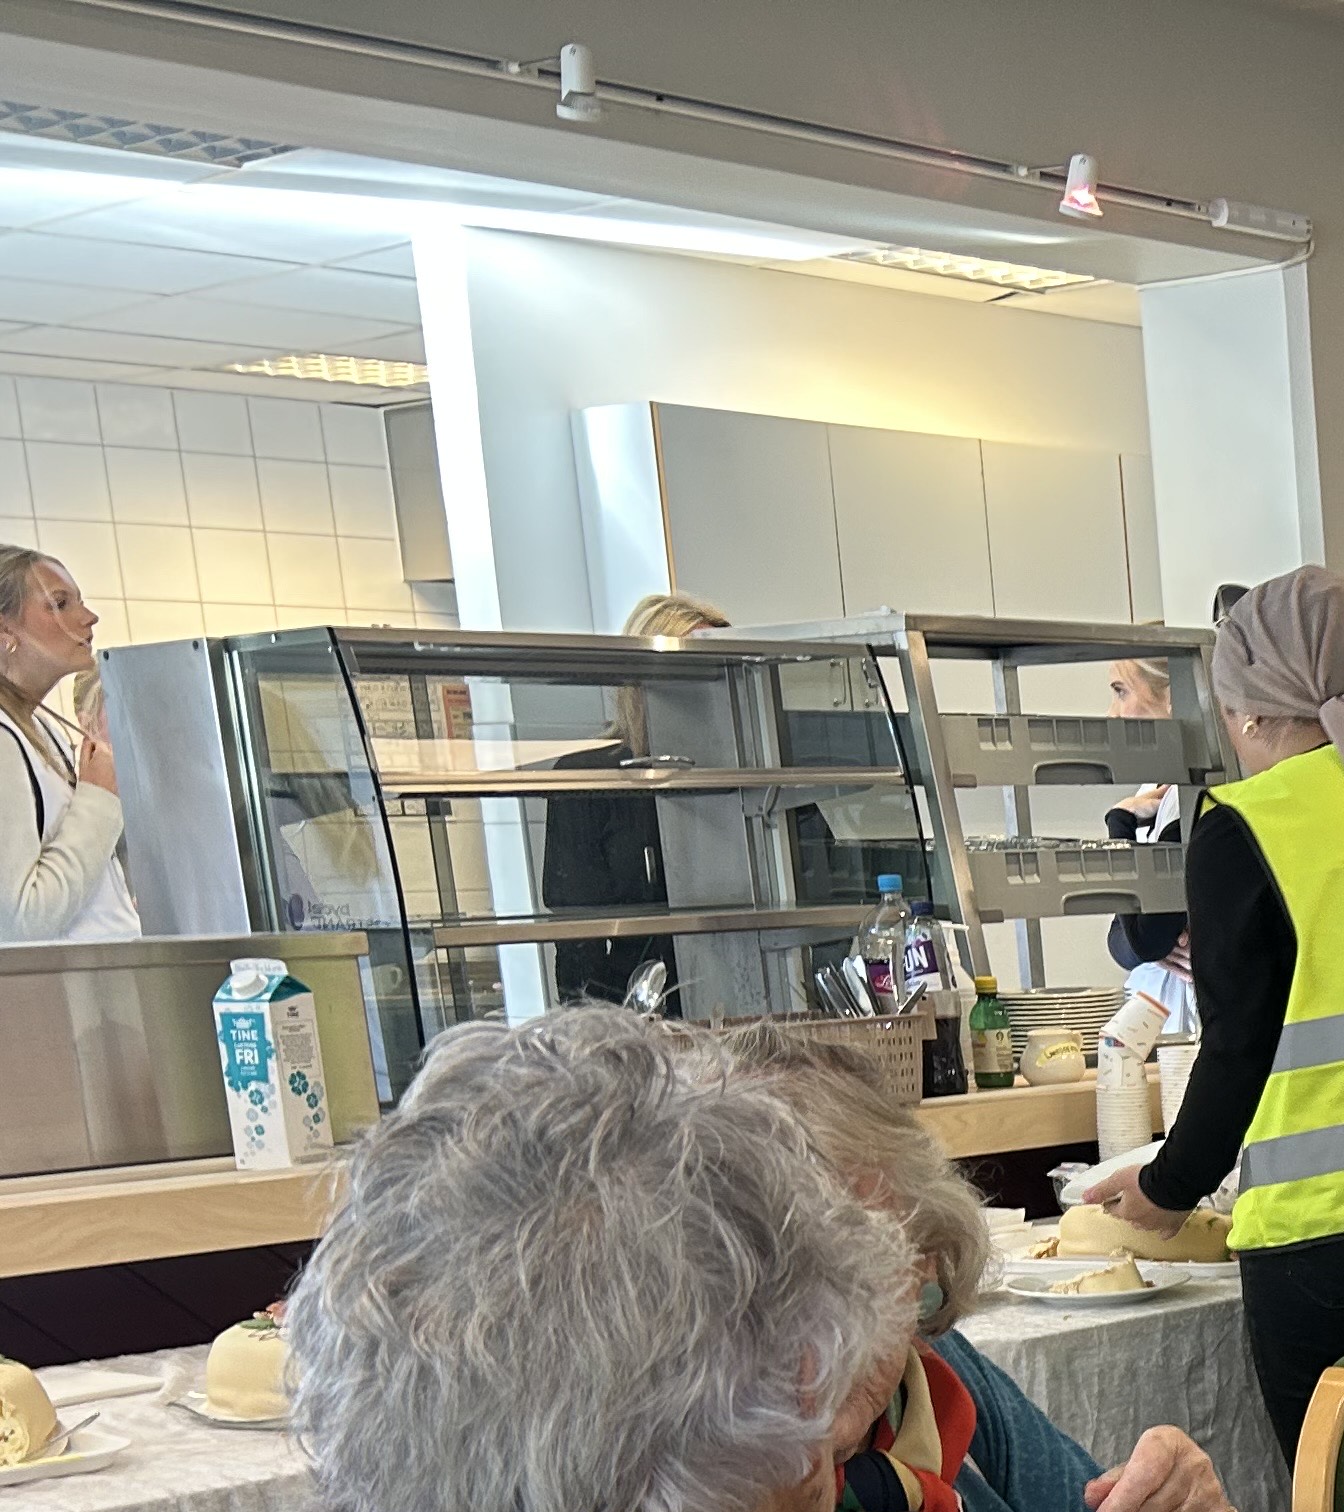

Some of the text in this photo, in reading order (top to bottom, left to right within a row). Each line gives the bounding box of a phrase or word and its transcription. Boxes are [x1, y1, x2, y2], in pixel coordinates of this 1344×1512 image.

[903, 945, 929, 972] UN
[230, 1030, 259, 1042] TINE
[235, 1049, 260, 1065] FRI
